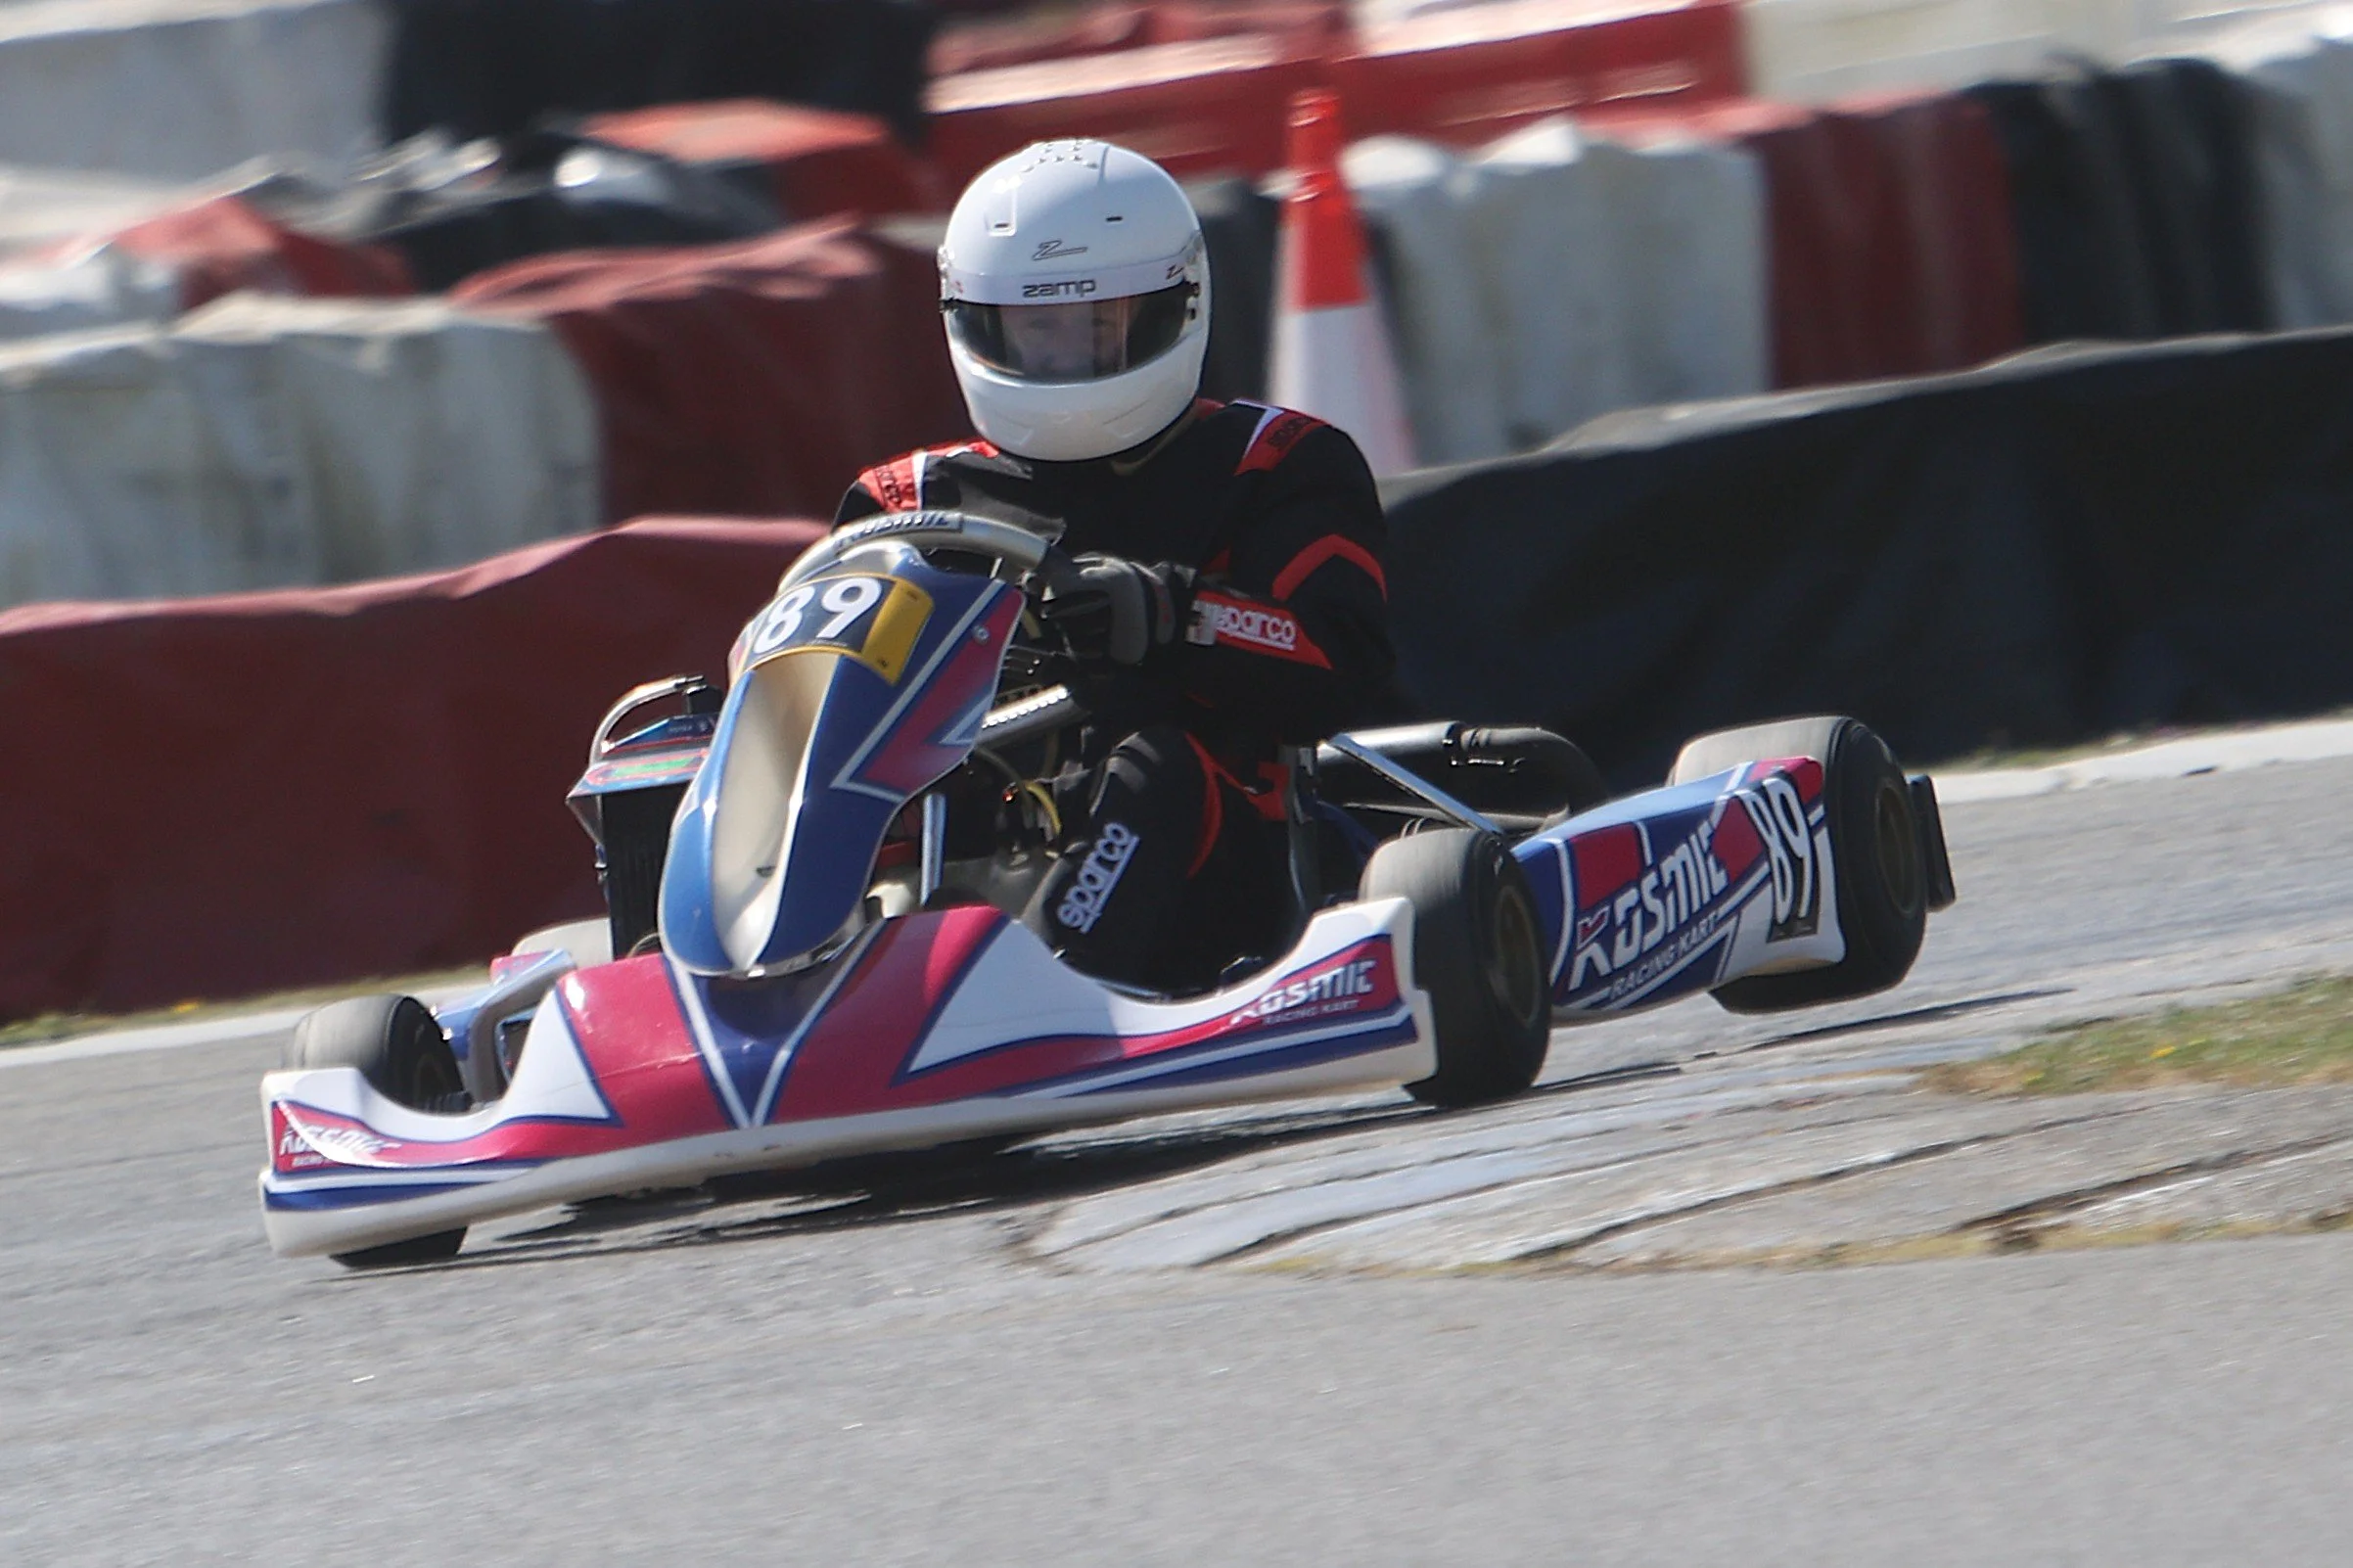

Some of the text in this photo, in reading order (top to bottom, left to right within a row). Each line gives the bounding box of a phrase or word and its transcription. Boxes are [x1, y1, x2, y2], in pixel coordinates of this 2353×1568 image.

[1023, 278, 1097, 298] zamp
[753, 576, 883, 656] 89
[1057, 822, 1141, 936] sparco
[1732, 776, 1813, 926] 89
